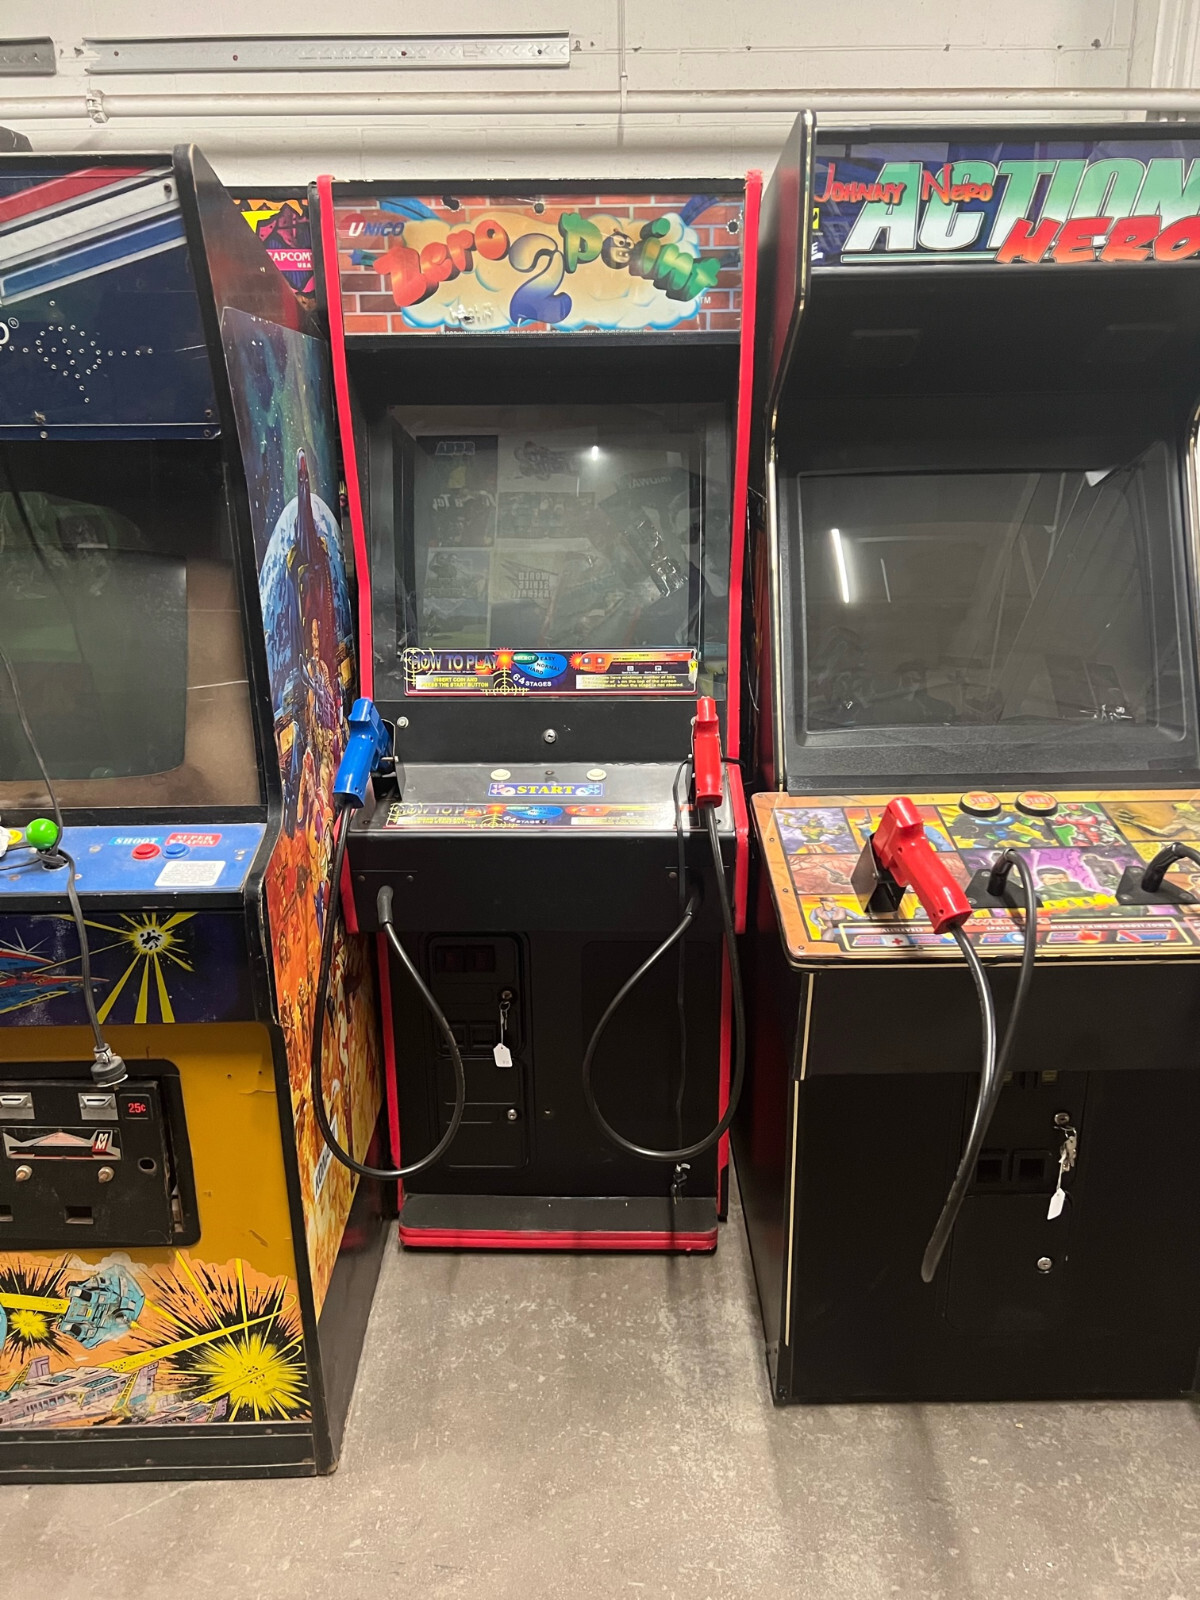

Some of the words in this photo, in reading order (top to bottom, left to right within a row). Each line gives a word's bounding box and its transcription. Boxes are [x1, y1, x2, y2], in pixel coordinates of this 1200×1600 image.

[841, 157, 1200, 251] ACTION
[348, 221, 405, 237] UNICO
[994, 214, 1200, 264] HERO
[268, 252, 311, 261] APCOM
[508, 232, 573, 324] 2
[411, 654, 442, 671] HOW
[445, 654, 463, 671] TO
[466, 654, 498, 671] PLAY
[536, 662, 560, 671] NORMAL
[528, 666, 544, 675] HARD
[512, 673, 526, 685] 64
[516, 785, 575, 794] START
[127, 1102, 147, 1114] 25¢
